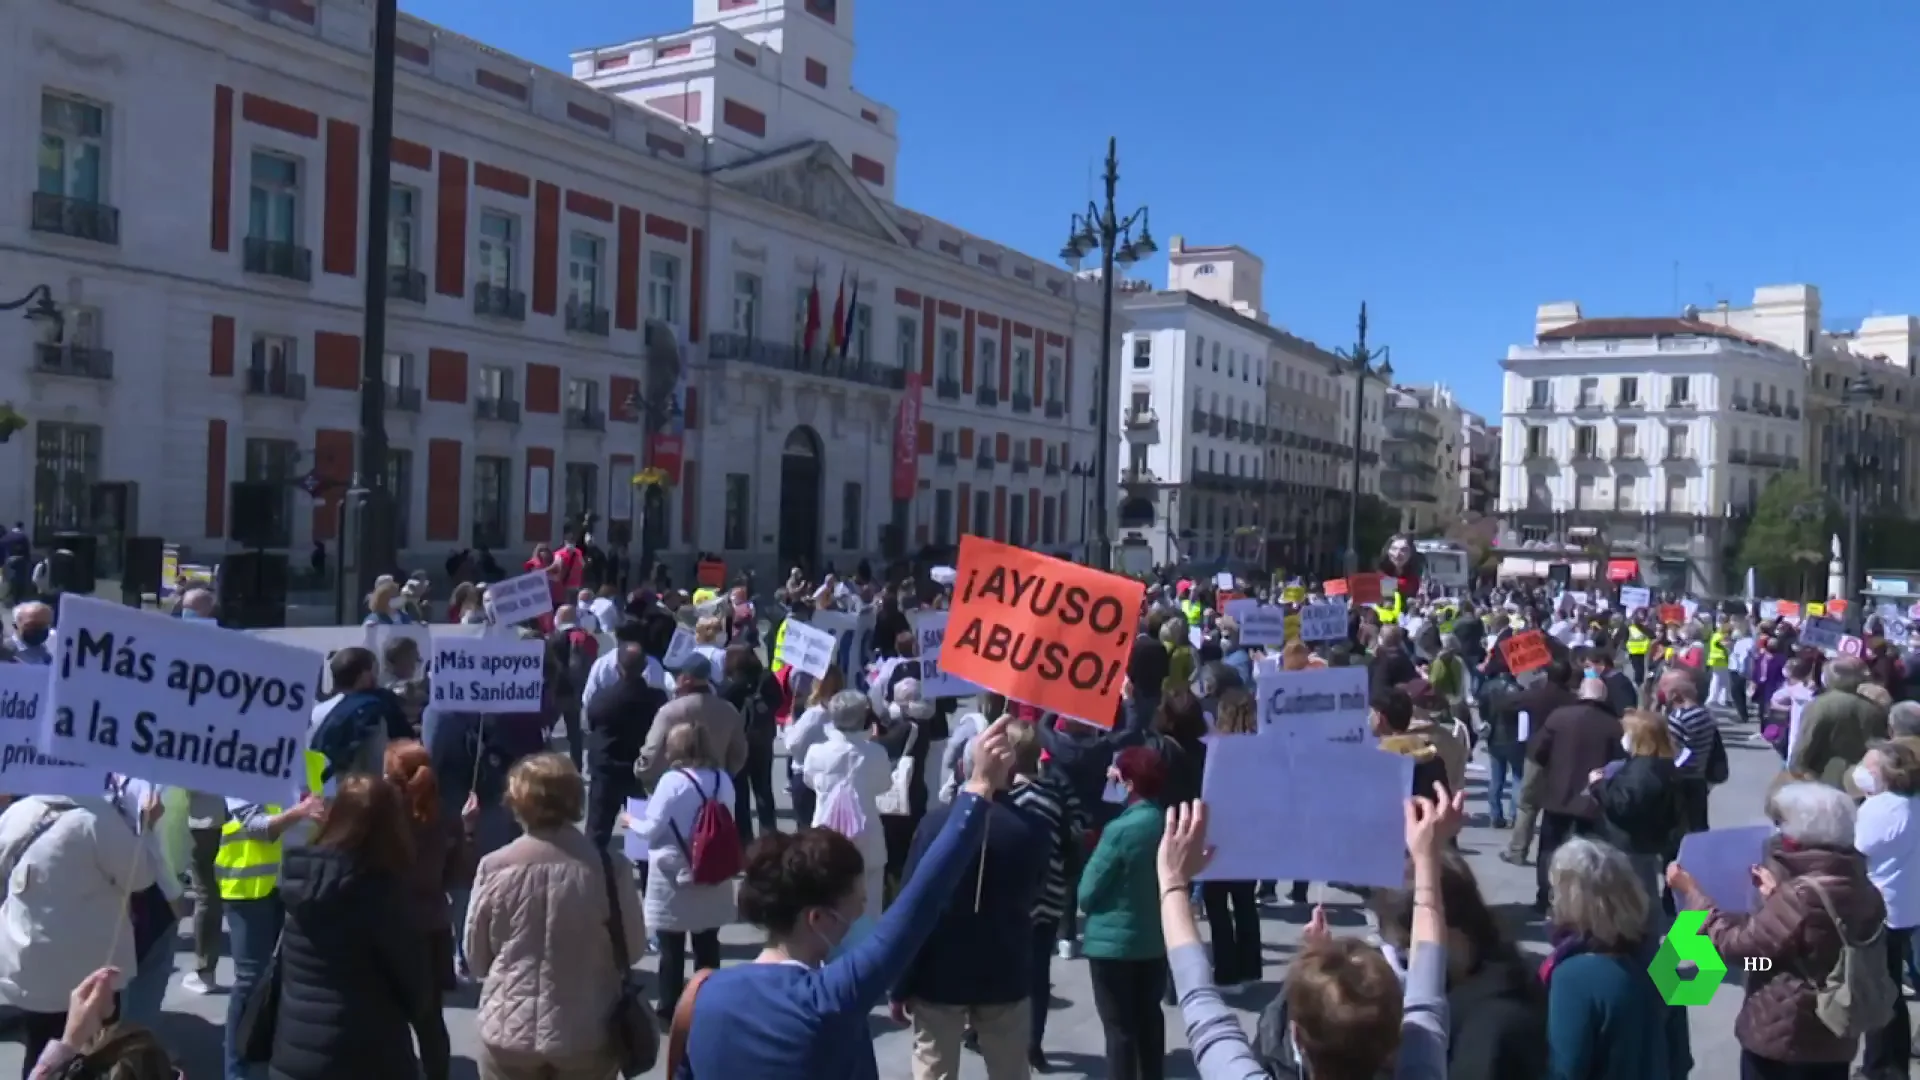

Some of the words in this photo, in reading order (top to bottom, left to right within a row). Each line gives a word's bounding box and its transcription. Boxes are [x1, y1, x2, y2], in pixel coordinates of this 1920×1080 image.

[962, 565, 1129, 646] ¡AYUSO,
[61, 627, 156, 682] ¡Más
[167, 658, 306, 715] apoyos
[434, 649, 475, 674] ¡Más
[480, 655, 541, 676] apoyos
[434, 684, 444, 700] a
[449, 681, 465, 700] la
[470, 680, 540, 701] Sanidad!
[954, 617, 1122, 696] ABUSO!
[0, 688, 39, 720] idad
[54, 704, 74, 738] a
[88, 700, 119, 747] la
[131, 711, 297, 780] Sanidad!
